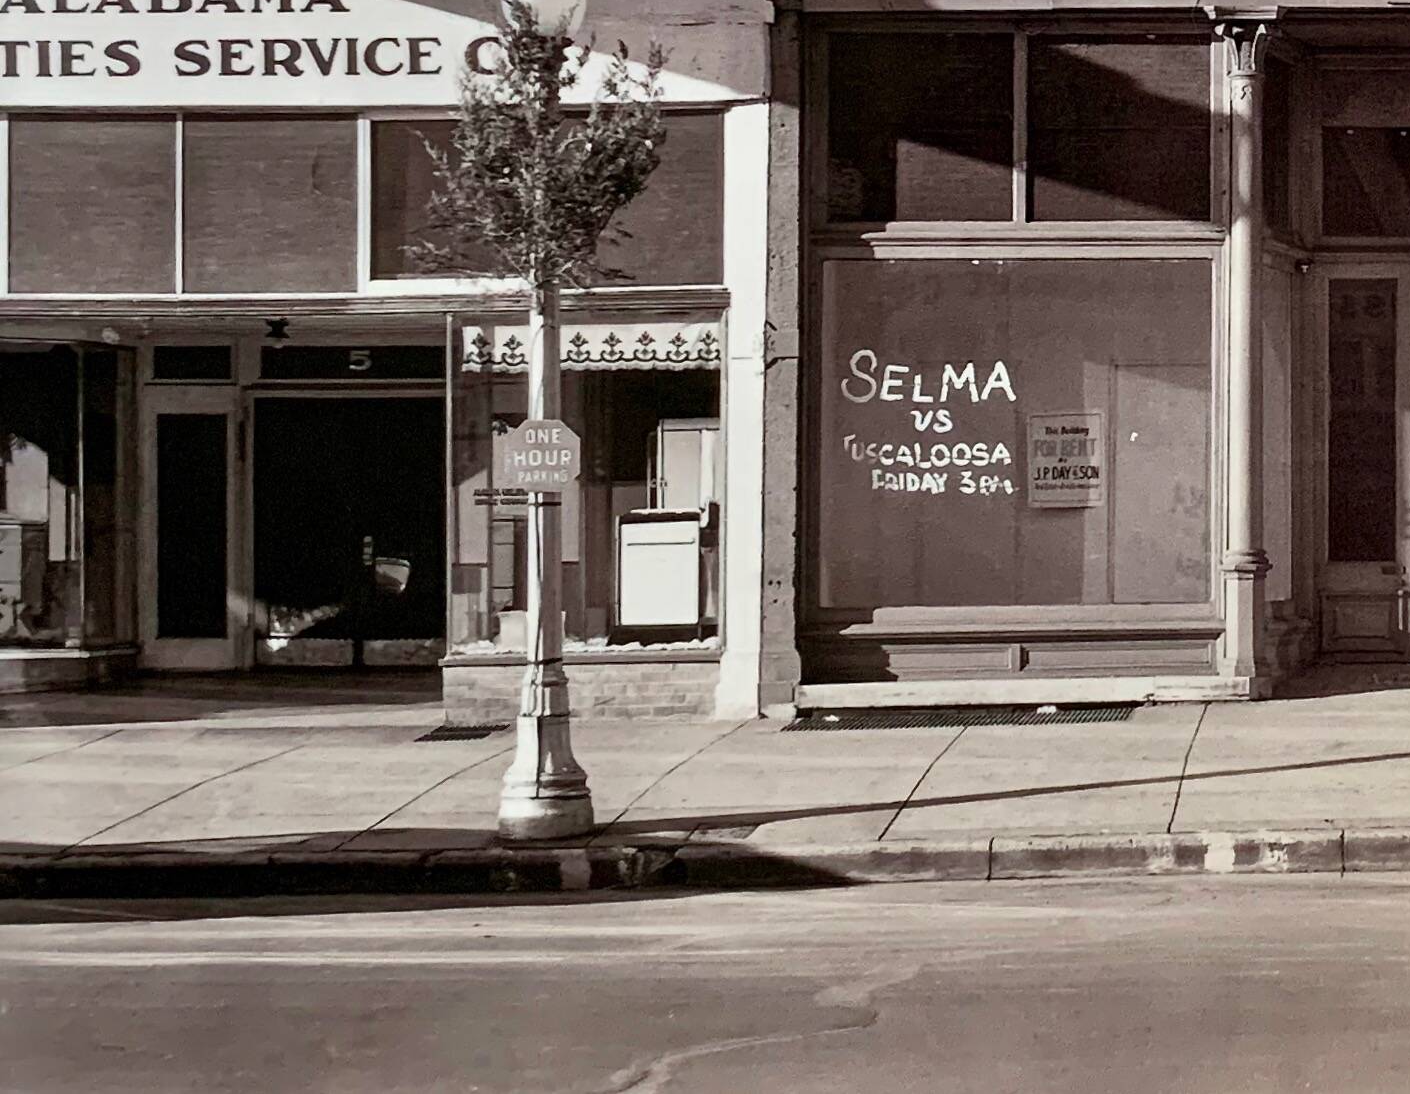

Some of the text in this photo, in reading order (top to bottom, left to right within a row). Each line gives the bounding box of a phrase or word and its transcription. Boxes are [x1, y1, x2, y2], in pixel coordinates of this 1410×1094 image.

[0, 39, 141, 78] TIES
[174, 38, 442, 77] SERVICE
[349, 350, 371, 370] 5
[841, 349, 1017, 403] SELMA
[526, 428, 561, 445] ONE
[843, 434, 1012, 468] TUSCALOOSA
[1034, 438, 1097, 457] FOR RENT
[513, 450, 571, 467] HOUR
[518, 469, 568, 483] PARKING
[871, 469, 948, 494] FRIDAY
[959, 471, 977, 494] 3
